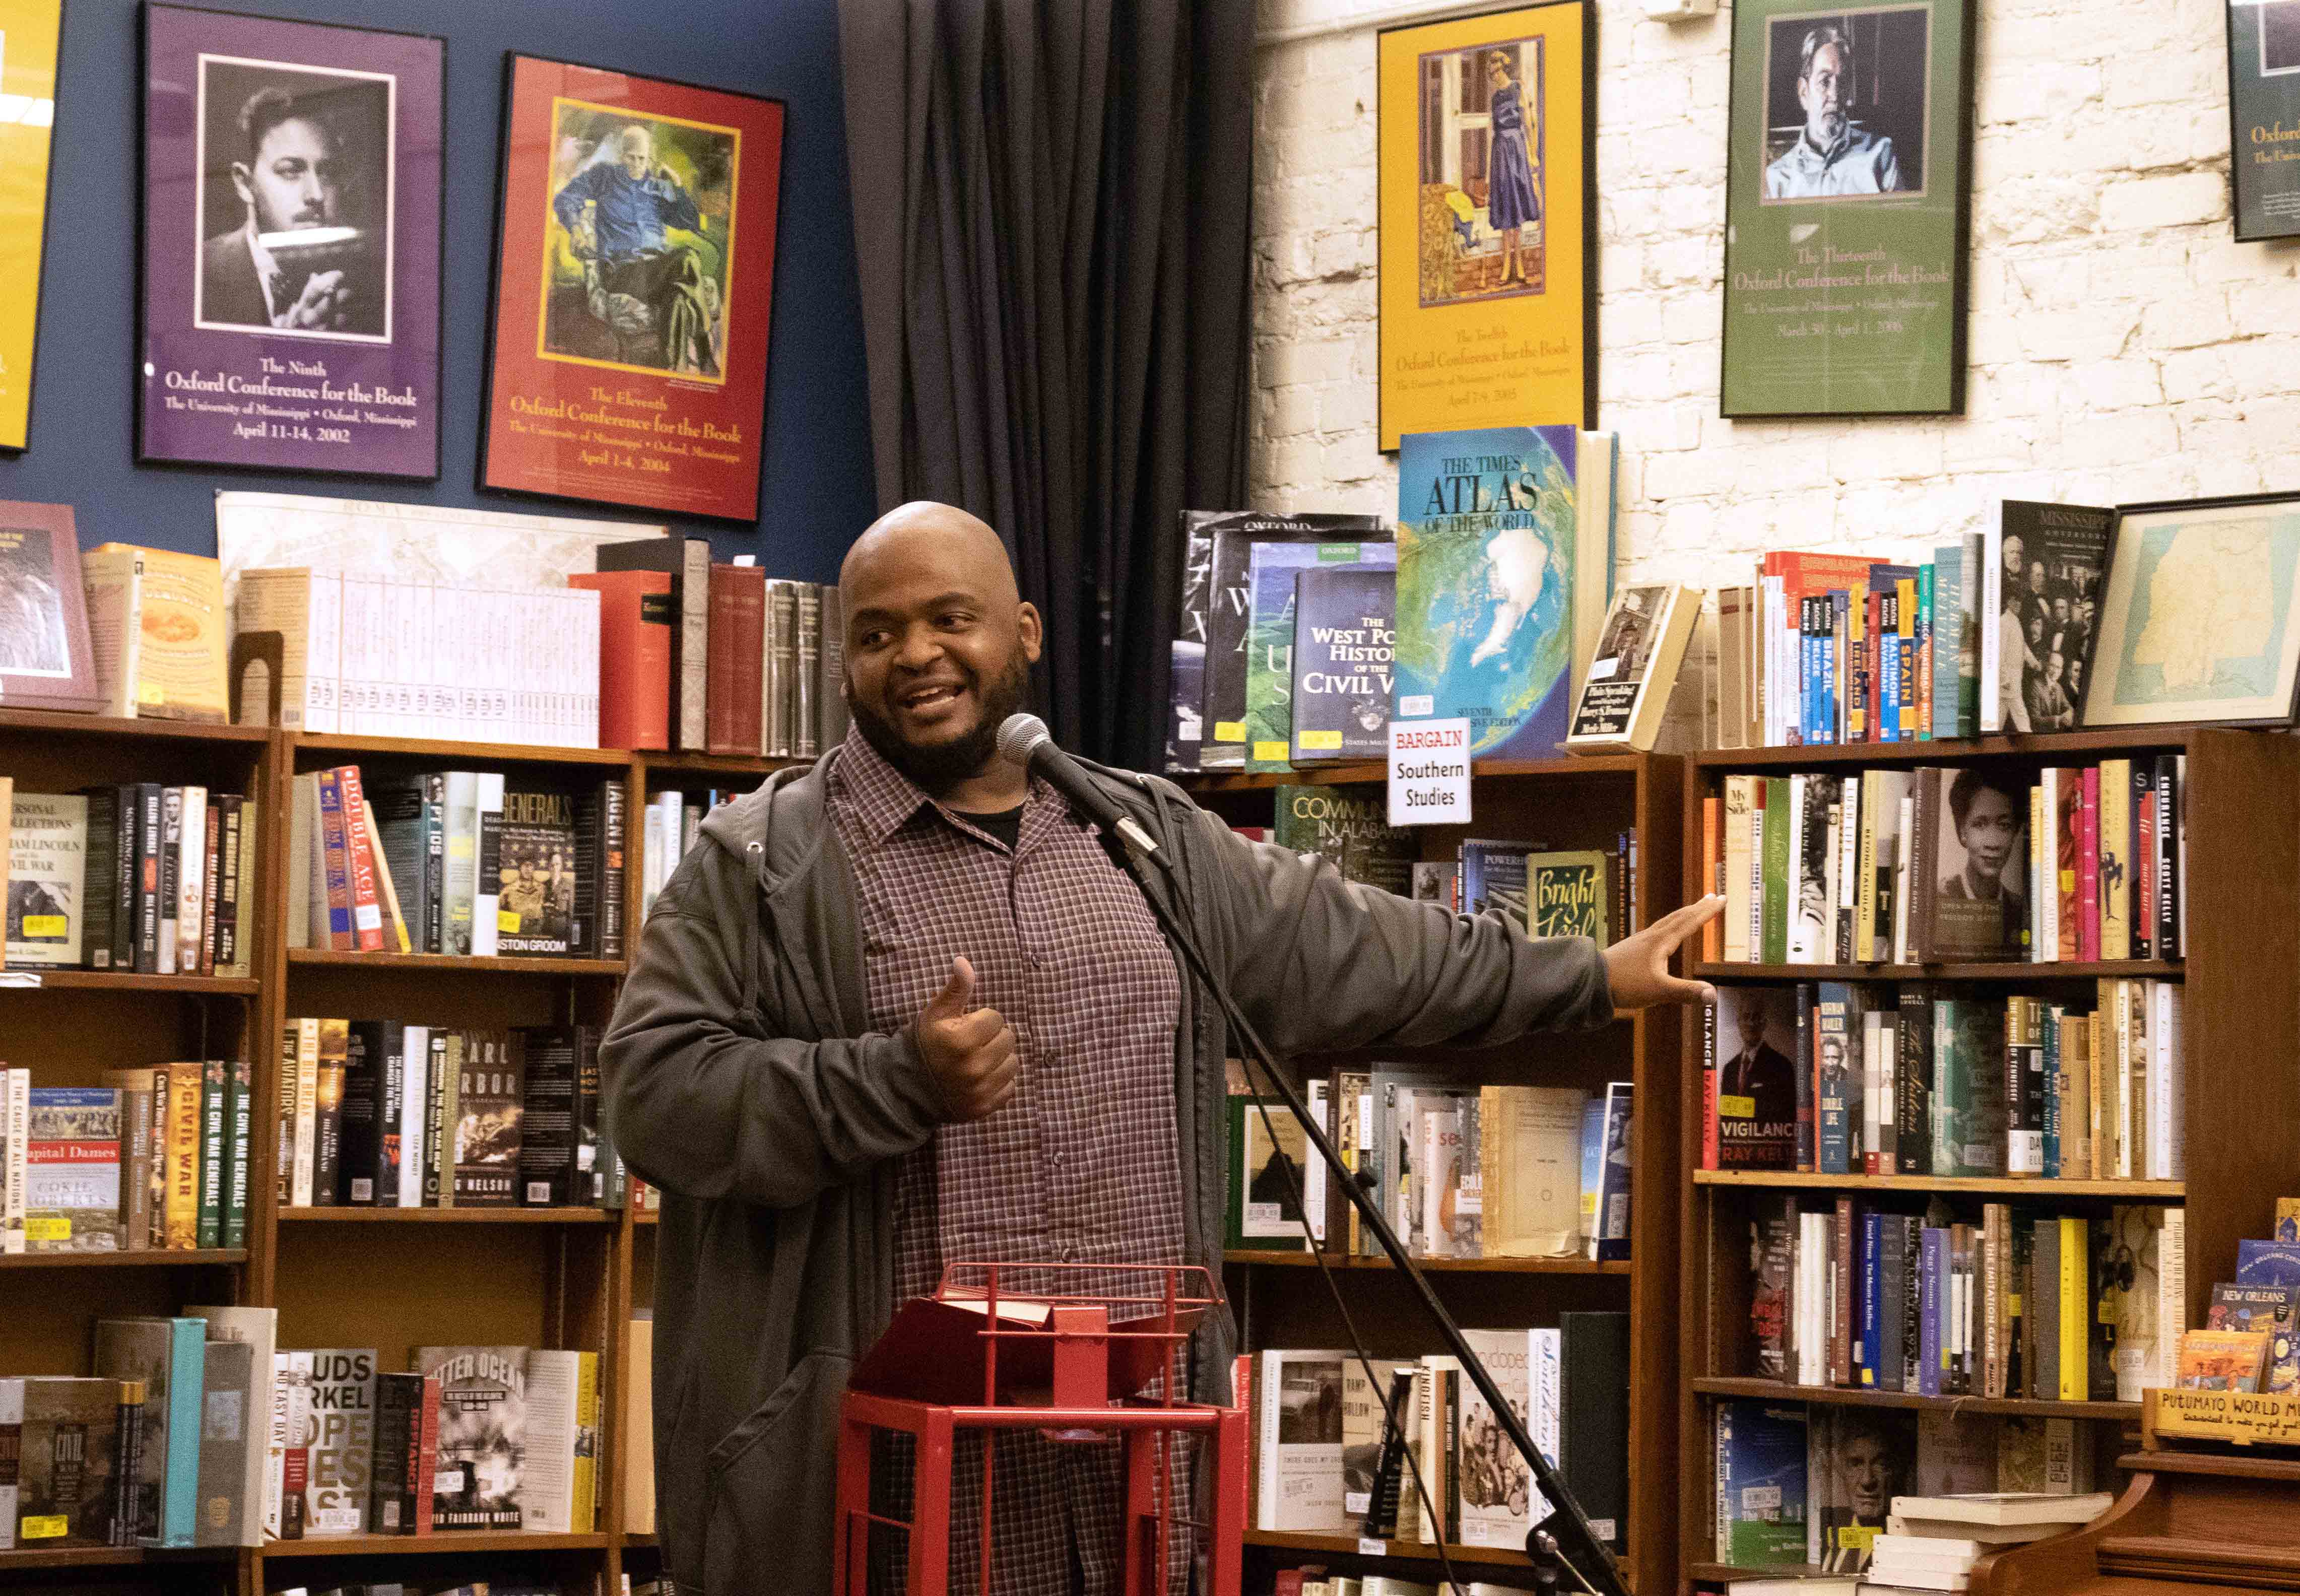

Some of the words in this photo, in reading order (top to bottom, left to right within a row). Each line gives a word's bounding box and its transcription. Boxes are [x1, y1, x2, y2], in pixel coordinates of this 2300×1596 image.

[1798, 248, 1820, 264] The
[1734, 268, 1783, 291] Oxford
[1785, 267, 1863, 289] Conference
[1865, 264, 1887, 285] for
[1888, 262, 1910, 285] the
[1912, 261, 1950, 284] Book
[1396, 350, 1436, 372] Oxford
[1437, 347, 1500, 368] Conference
[1540, 336, 1572, 357] Book
[260, 357, 285, 374] The
[289, 359, 326, 377] Ninth
[165, 371, 225, 391] Oxford
[227, 376, 319, 400] Conference
[321, 380, 346, 401] for
[347, 383, 373, 404] the
[375, 386, 417, 407] Book
[591, 387, 613, 404] The
[616, 390, 669, 412] Eleventh
[164, 396, 185, 411] The
[510, 395, 565, 419] Oxford
[568, 402, 650, 432] Conference
[653, 414, 676, 434] for
[677, 418, 701, 439] the
[703, 422, 742, 444] Book
[233, 421, 267, 439] April
[271, 424, 313, 442] 11-14,
[317, 427, 351, 444] 2002
[579, 449, 609, 468] April
[1442, 456, 1476, 474] THE
[1477, 455, 1521, 473] TIMES
[1423, 472, 1537, 516] ATLAS
[1424, 517, 1443, 535] OF
[1447, 516, 1482, 534] THE
[1484, 514, 1535, 531] WORLD
[1361, 617, 1385, 628] THE
[1937, 575, 1948, 671] MELVILLE
[1949, 584, 1960, 662] HERMAN
[1310, 627, 1366, 645] WEST
[1329, 646, 1396, 662] HISTO
[1823, 639, 1833, 693] BRAZIL
[1854, 645, 1862, 706] IRELAND
[1889, 635, 1898, 707] BALTIMORE
[1901, 644, 1911, 700] SPAIN
[1301, 673, 1374, 695] CIVIL
[1395, 730, 1463, 750] BARGAIN
[1397, 760, 1464, 780] Southern
[1406, 787, 1456, 807] Studies
[1731, 788, 1746, 804] My
[2160, 776, 2171, 838] ENDURANCE
[226, 812, 239, 829] THE
[430, 806, 442, 824] PT
[608, 790, 624, 846] AGENT
[33, 839, 81, 851] LINCOLN
[123, 806, 134, 861] MOURNING
[346, 779, 369, 854] DOUBLE
[358, 864, 374, 900] ACE
[431, 830, 442, 855] 109
[1845, 826, 1853, 852] LIFE
[225, 831, 238, 877] AMERICAN
[122, 863, 132, 908] LINCOLN
[2162, 858, 2171, 889] SCOTT
[223, 878, 235, 903] WEST
[1539, 869, 1603, 924] Bright
[2162, 893, 2172, 922] KELLY
[1704, 1005, 1712, 1066] IGILANCE
[2010, 1017, 2018, 1042] PRINCE
[283, 1039, 294, 1054] THE
[303, 1036, 315, 1054] THE
[2010, 1047, 2018, 1057] OF
[302, 1060, 315, 1077] BIG
[386, 1055, 396, 1085] CHANGED
[14, 1086, 23, 1100] THE
[280, 1058, 296, 1115] AVIATORS
[385, 1087, 395, 1098] THE
[2010, 1060, 2018, 1102] TENNESSEE
[209, 1092, 222, 1109] THE
[237, 1094, 250, 1111] THE
[301, 1083, 314, 1117] BREAK
[385, 1100, 394, 1123] WORLD
[436, 1092, 444, 1107] THE
[14, 1105, 23, 1134] CAUSE
[181, 1091, 194, 1146] CIVIL
[209, 1111, 221, 1134] CIVIL
[236, 1112, 249, 1136] CIVIL
[435, 1108, 444, 1128] CIVIL
[13, 1138, 22, 1149] OF
[207, 1137, 221, 1157] WAR
[234, 1138, 248, 1159] WAR
[321, 1118, 332, 1172] HILLENBRAND
[330, 1133, 338, 1157] LAURA
[434, 1130, 443, 1149] WAR
[13, 1153, 22, 1167] ALL
[27, 1146, 65, 1162] apital
[69, 1146, 116, 1158] Dames
[433, 1151, 442, 1172] DEAD
[179, 1153, 192, 1196] WAR
[205, 1159, 220, 1207] GENERALS
[232, 1161, 247, 1208] GENERALS
[12, 1171, 21, 1210] NATIONS
[1987, 1242, 1995, 1264] THE
[1987, 1267, 1995, 1324] IMITATION
[2222, 1290, 2245, 1301] NEW
[2245, 1291, 2286, 1303] ORLEANS
[1987, 1326, 1996, 1359] GAME
[277, 1370, 288, 1384] NO
[313, 1355, 371, 1382] UDS
[275, 1389, 286, 1417] EASY
[311, 1386, 370, 1409] RKEL
[1420, 1365, 1430, 1421] KINGFISH
[2233, 1398, 2280, 1416] WORLD
[274, 1422, 285, 1442] DAY
